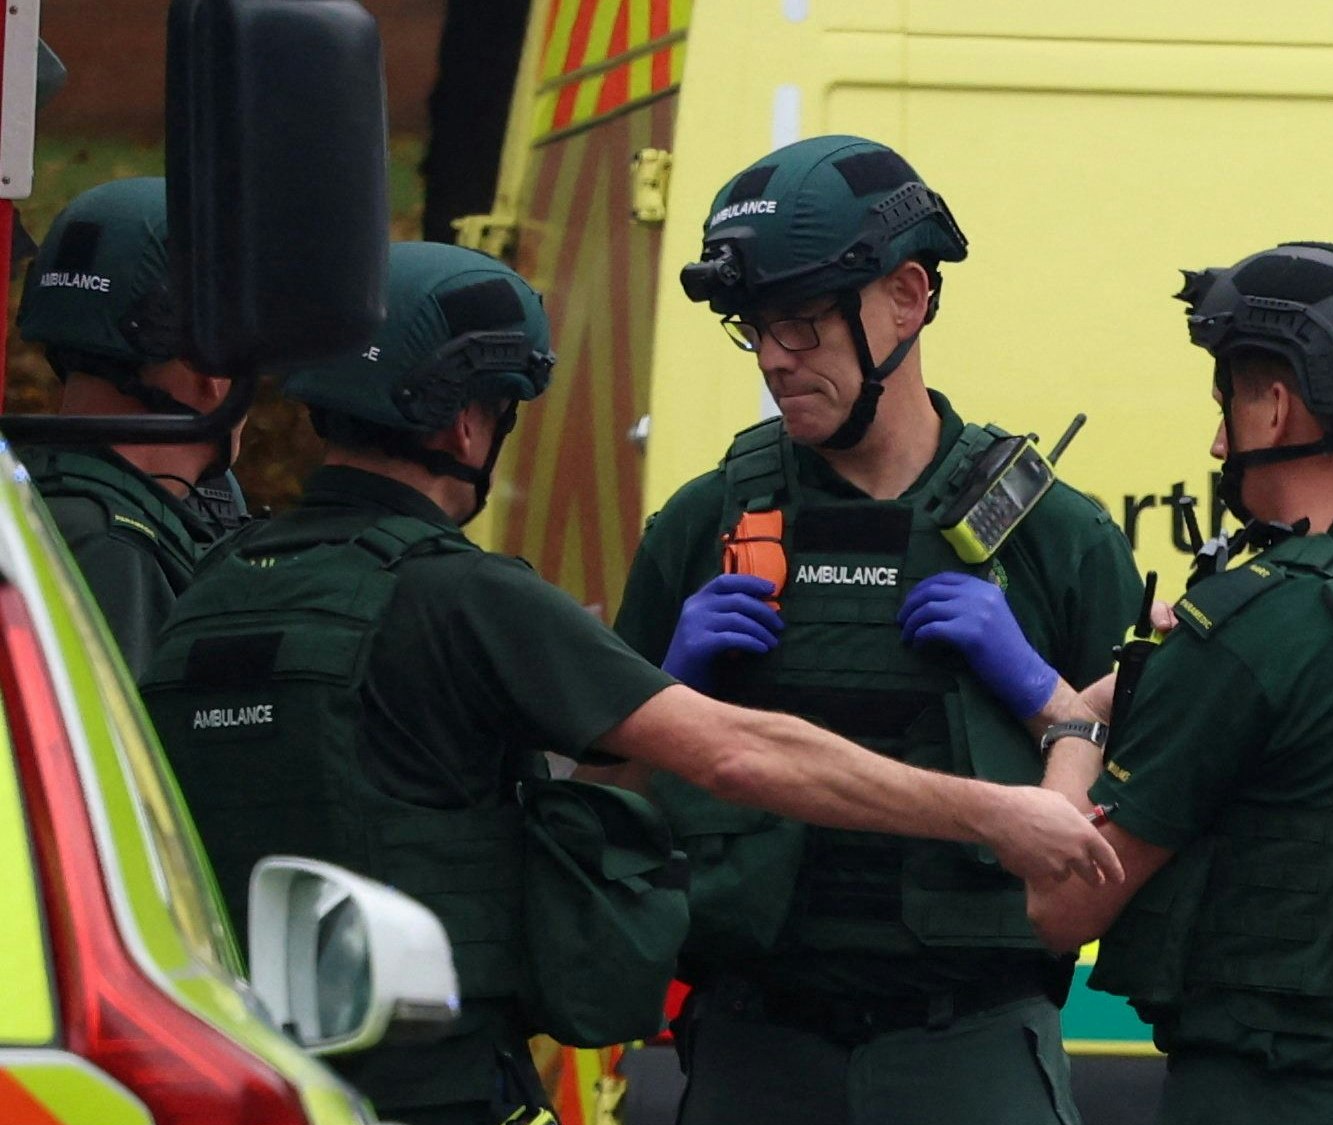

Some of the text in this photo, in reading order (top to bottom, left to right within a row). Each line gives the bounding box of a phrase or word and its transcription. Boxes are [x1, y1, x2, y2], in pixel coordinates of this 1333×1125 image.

[708, 200, 778, 229] AMBULANCE
[795, 565, 899, 586] AMBULANCE
[193, 704, 274, 730] AMBULANCE
